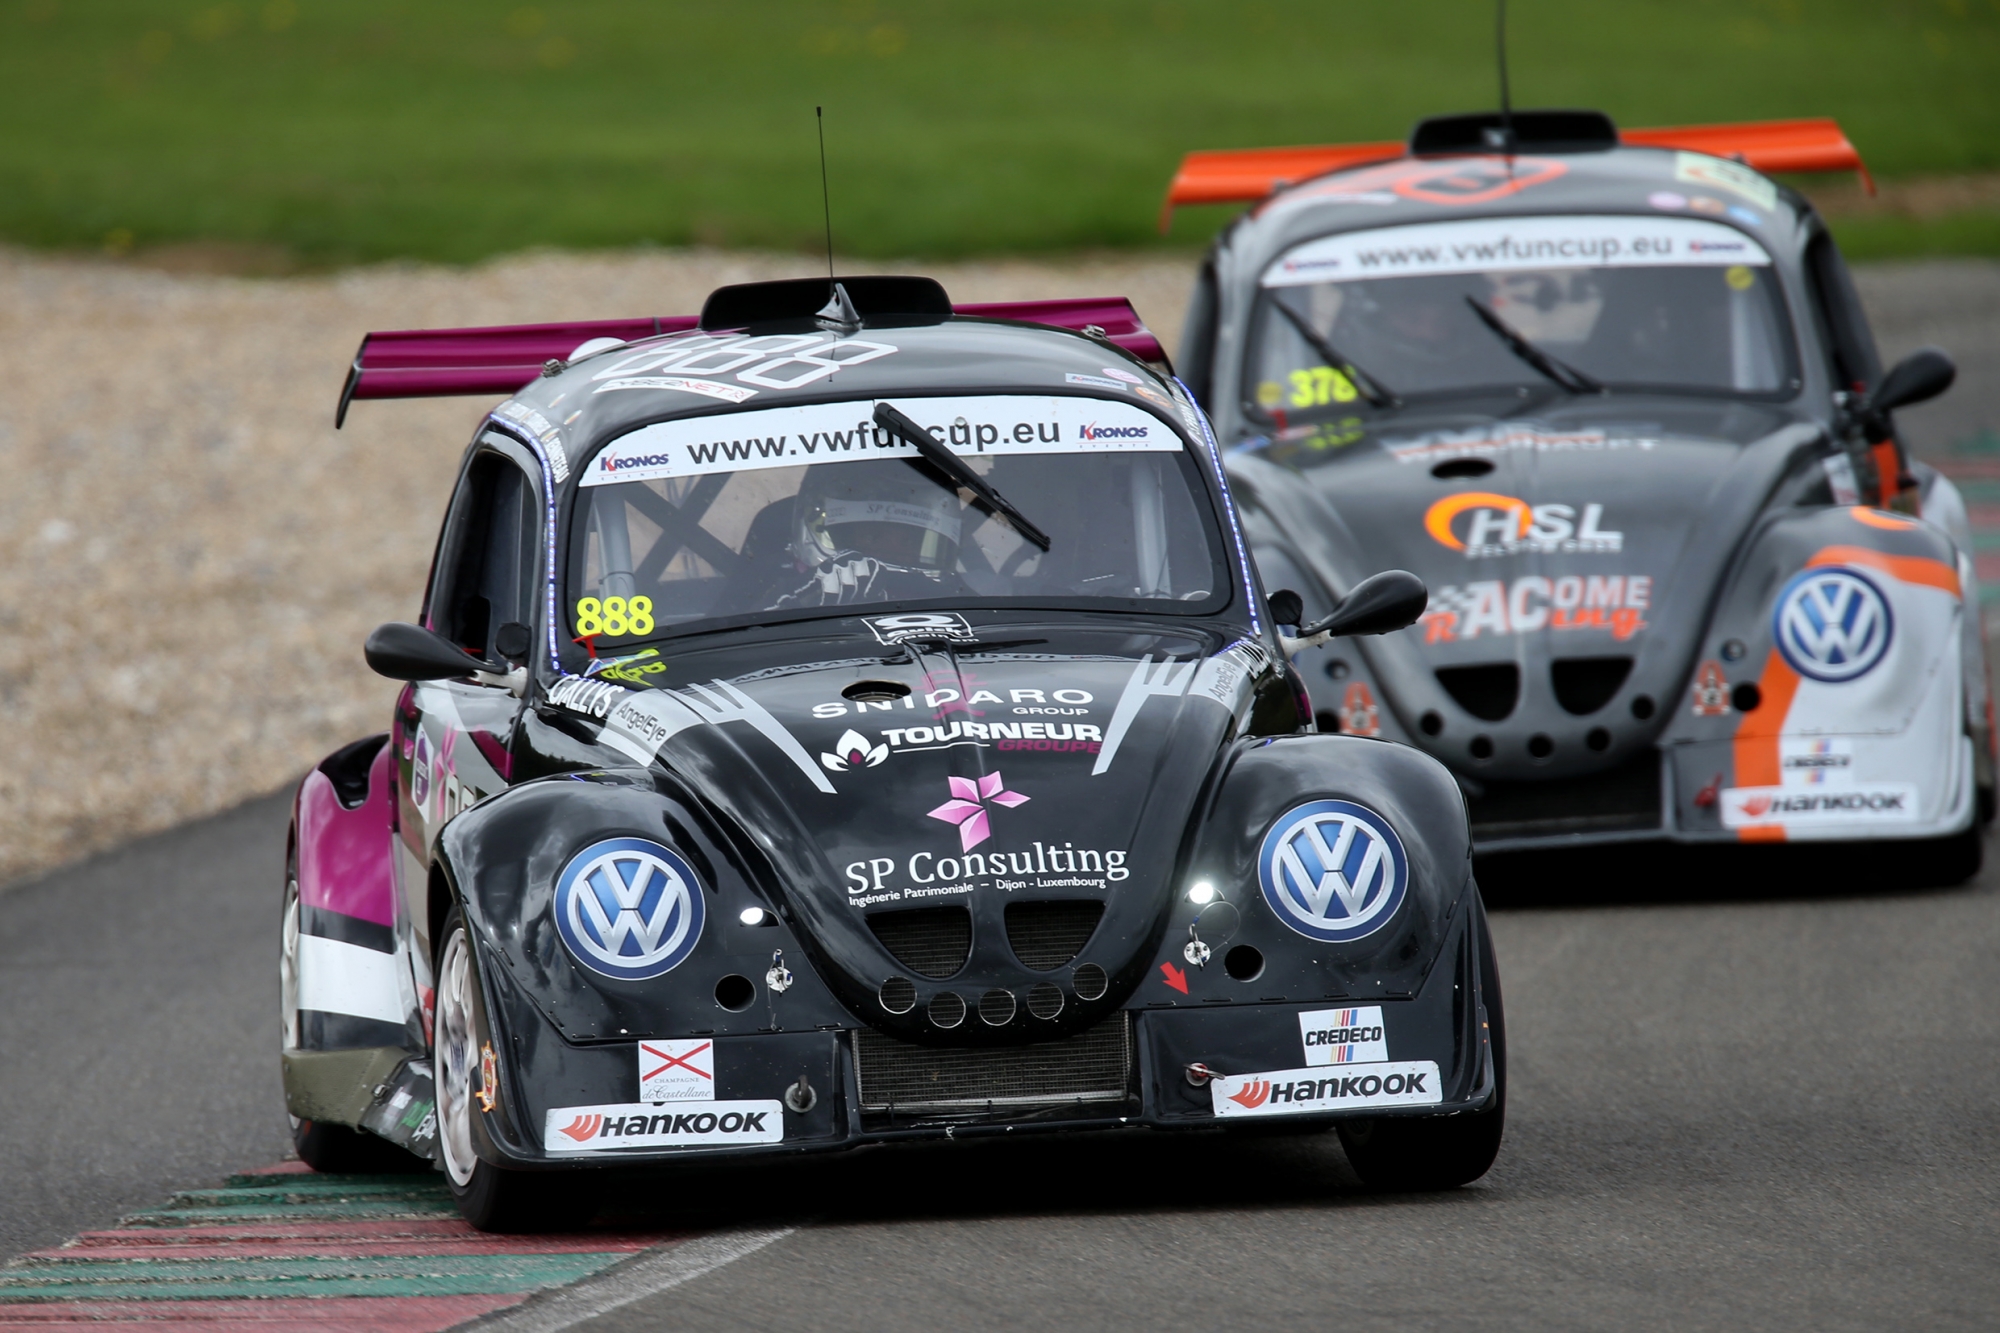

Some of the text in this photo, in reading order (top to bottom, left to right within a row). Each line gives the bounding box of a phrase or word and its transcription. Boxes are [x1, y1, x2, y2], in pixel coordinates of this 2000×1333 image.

[1356, 236, 1673, 267] www.vwfuncup.eu
[1079, 421, 1148, 441] KRONOS
[600, 452, 669, 472] KRONOS
[1467, 503, 1624, 547] HSL
[577, 595, 654, 637] 888
[617, 702, 667, 742] AngelEye
[1012, 706, 1089, 716] GROUP
[881, 721, 1103, 747] TOURNEUR
[997, 739, 1102, 754] GROUPE
[845, 842, 1130, 894] SP Consulting
[848, 891, 901, 908] Ingénerie
[904, 882, 974, 898] Patrimoniale
[996, 878, 1026, 893] Dijon
[1037, 876, 1106, 890] Luxembourg
[1305, 1026, 1383, 1046] CREDECO
